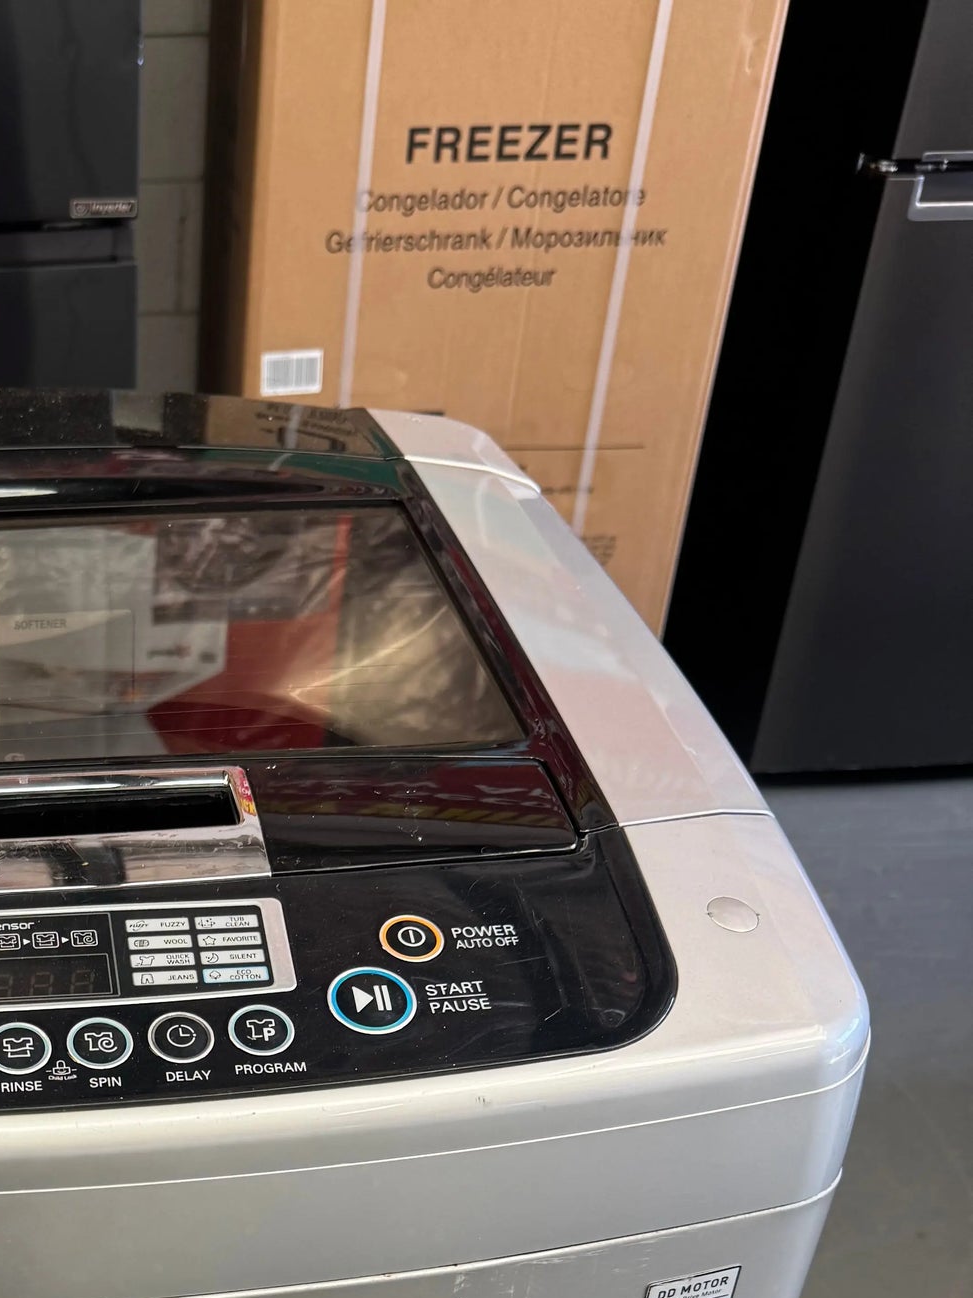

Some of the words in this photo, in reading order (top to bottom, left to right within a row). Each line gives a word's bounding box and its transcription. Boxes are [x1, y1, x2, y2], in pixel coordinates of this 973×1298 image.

[406, 124, 612, 164] FREEZER
[357, 189, 489, 217] Congelador
[427, 266, 558, 293] Congélateur
[14, 618, 67, 631] SOFTENER
[451, 924, 516, 938] POWER
[222, 935, 259, 943] FAVORITE
[456, 938, 493, 949] AUTO
[495, 936, 519, 947] OFF
[168, 973, 195, 981] JEANS
[425, 981, 484, 997] START
[430, 998, 492, 1014] PAUSE
[166, 1068, 212, 1082] DELAY
[235, 1061, 307, 1075] PROGRAM
[1, 1080, 44, 1093] RINSE
[89, 1077, 122, 1089] SPIN
[680, 1276, 729, 1295] MOTOR
